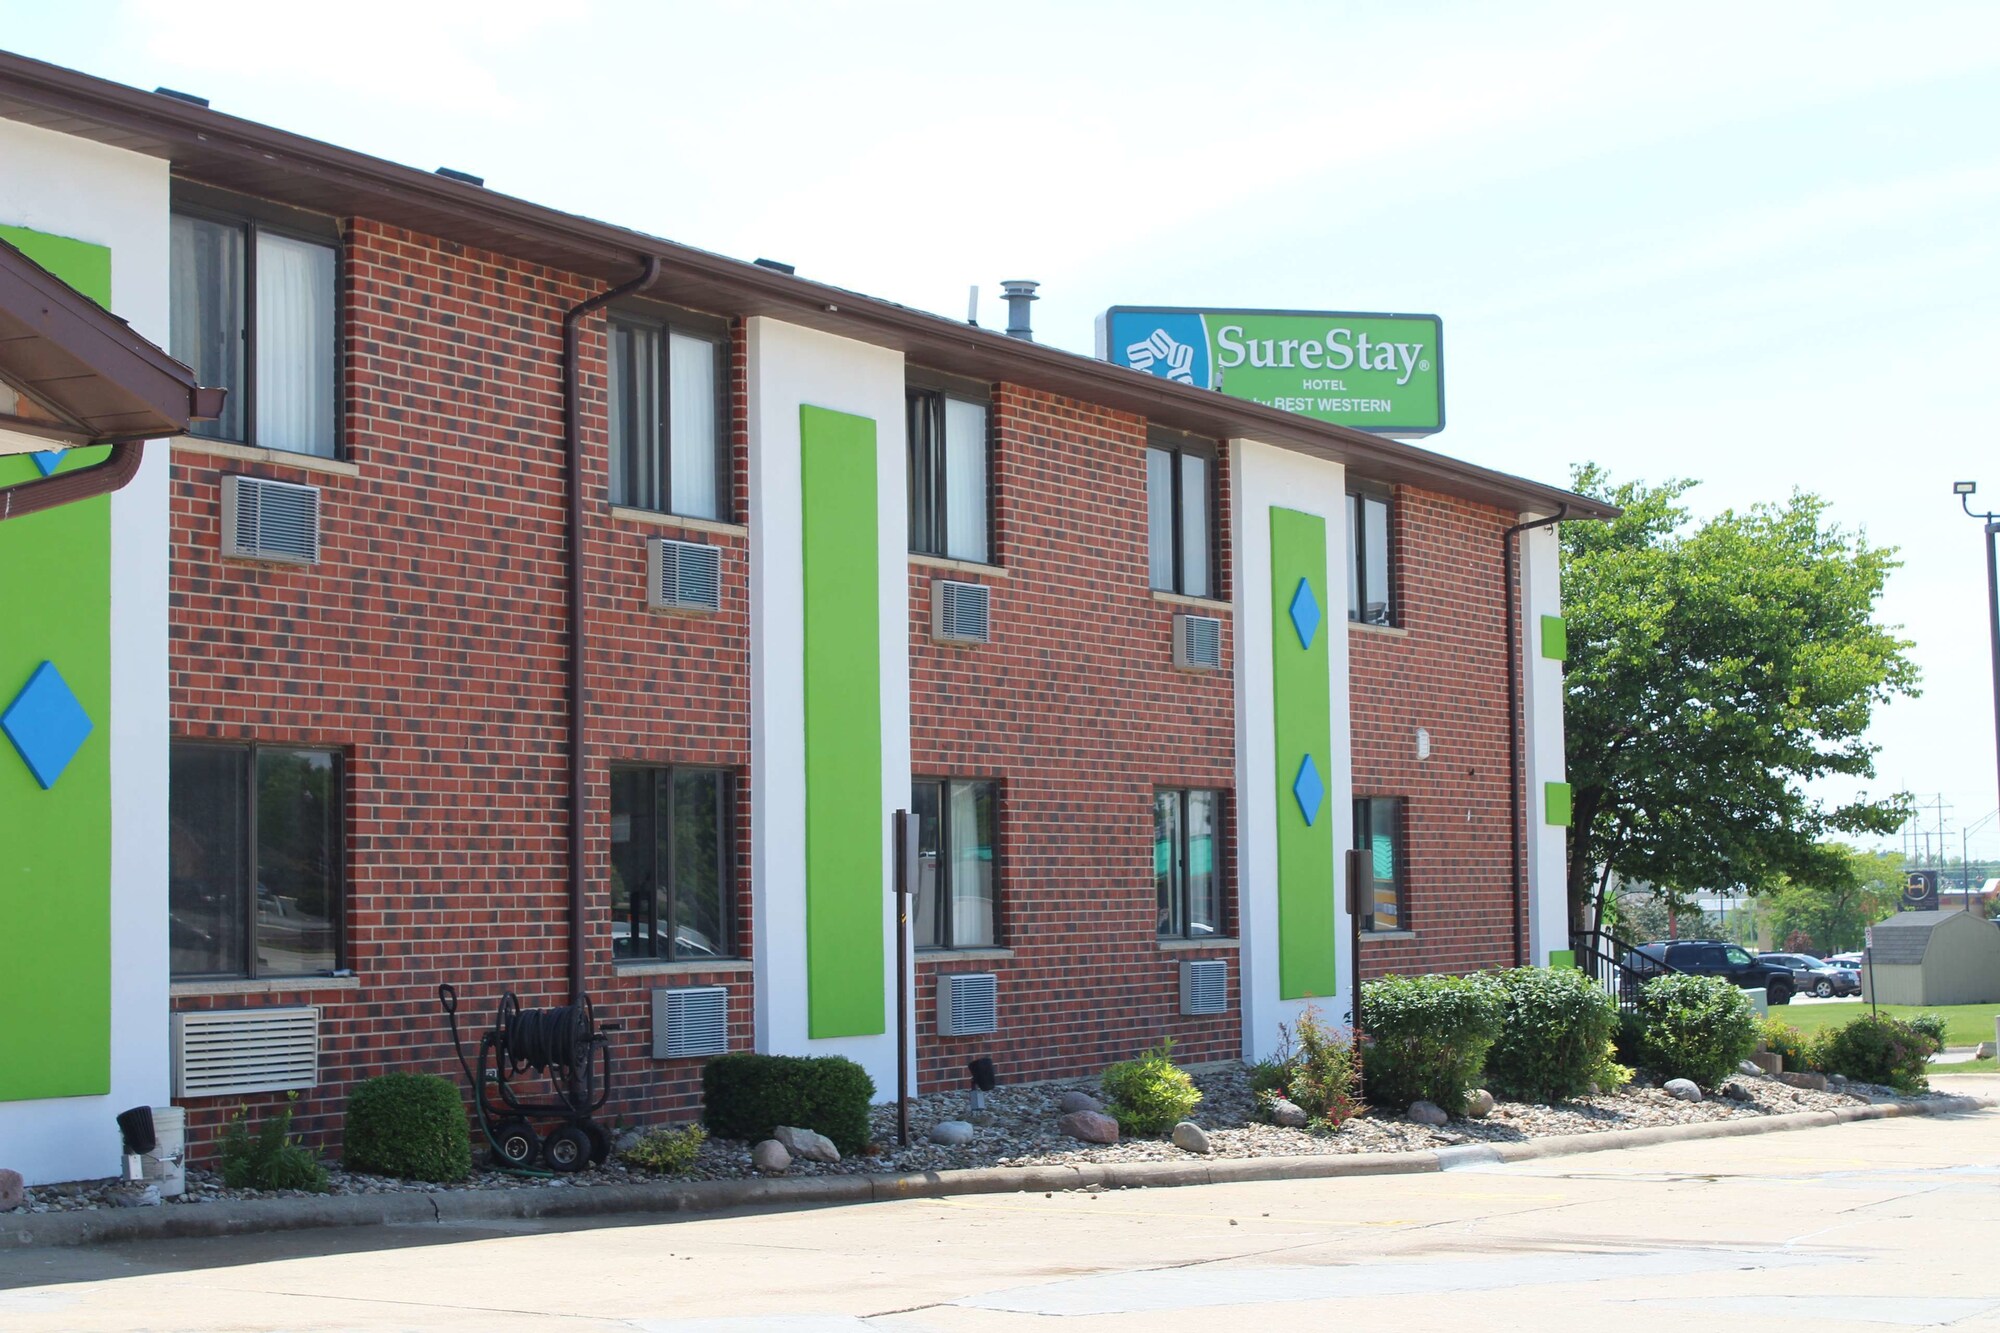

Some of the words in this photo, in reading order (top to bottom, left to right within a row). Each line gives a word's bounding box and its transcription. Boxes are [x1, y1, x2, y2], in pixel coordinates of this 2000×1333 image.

[1303, 379, 1347, 391] HOTEL
[1274, 397, 1314, 411] BEST
[1317, 398, 1391, 412] WESTERN
